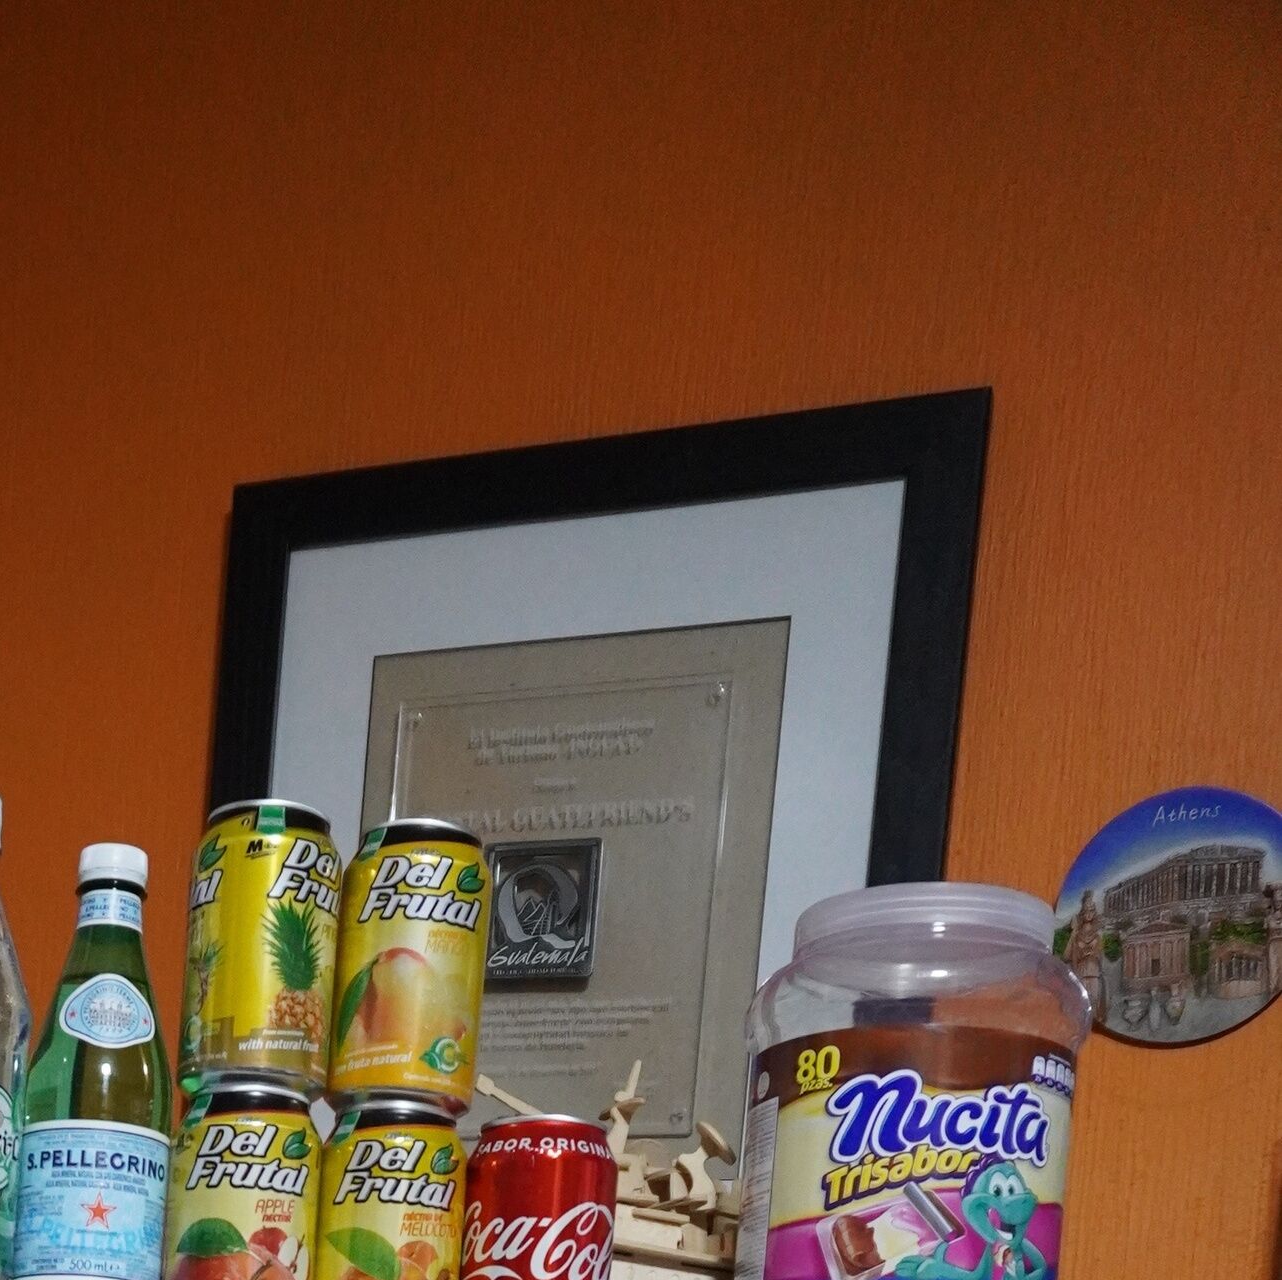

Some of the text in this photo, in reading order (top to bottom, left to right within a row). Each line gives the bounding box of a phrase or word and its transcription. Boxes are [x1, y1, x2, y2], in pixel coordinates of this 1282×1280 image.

[1152, 803, 1222, 827] Athens
[371, 856, 453, 890] Del
[358, 887, 481, 931] Frutal
[795, 1045, 842, 1085] 80
[828, 1068, 1051, 1168] Nucita
[197, 1124, 279, 1158] Del
[185, 1156, 309, 1196] Frutal
[332, 1171, 457, 1212] Frutal
[822, 1144, 982, 1212] Trisabor
[254, 1199, 296, 1214] APPLE
[69, 1258, 92, 1272] 500
